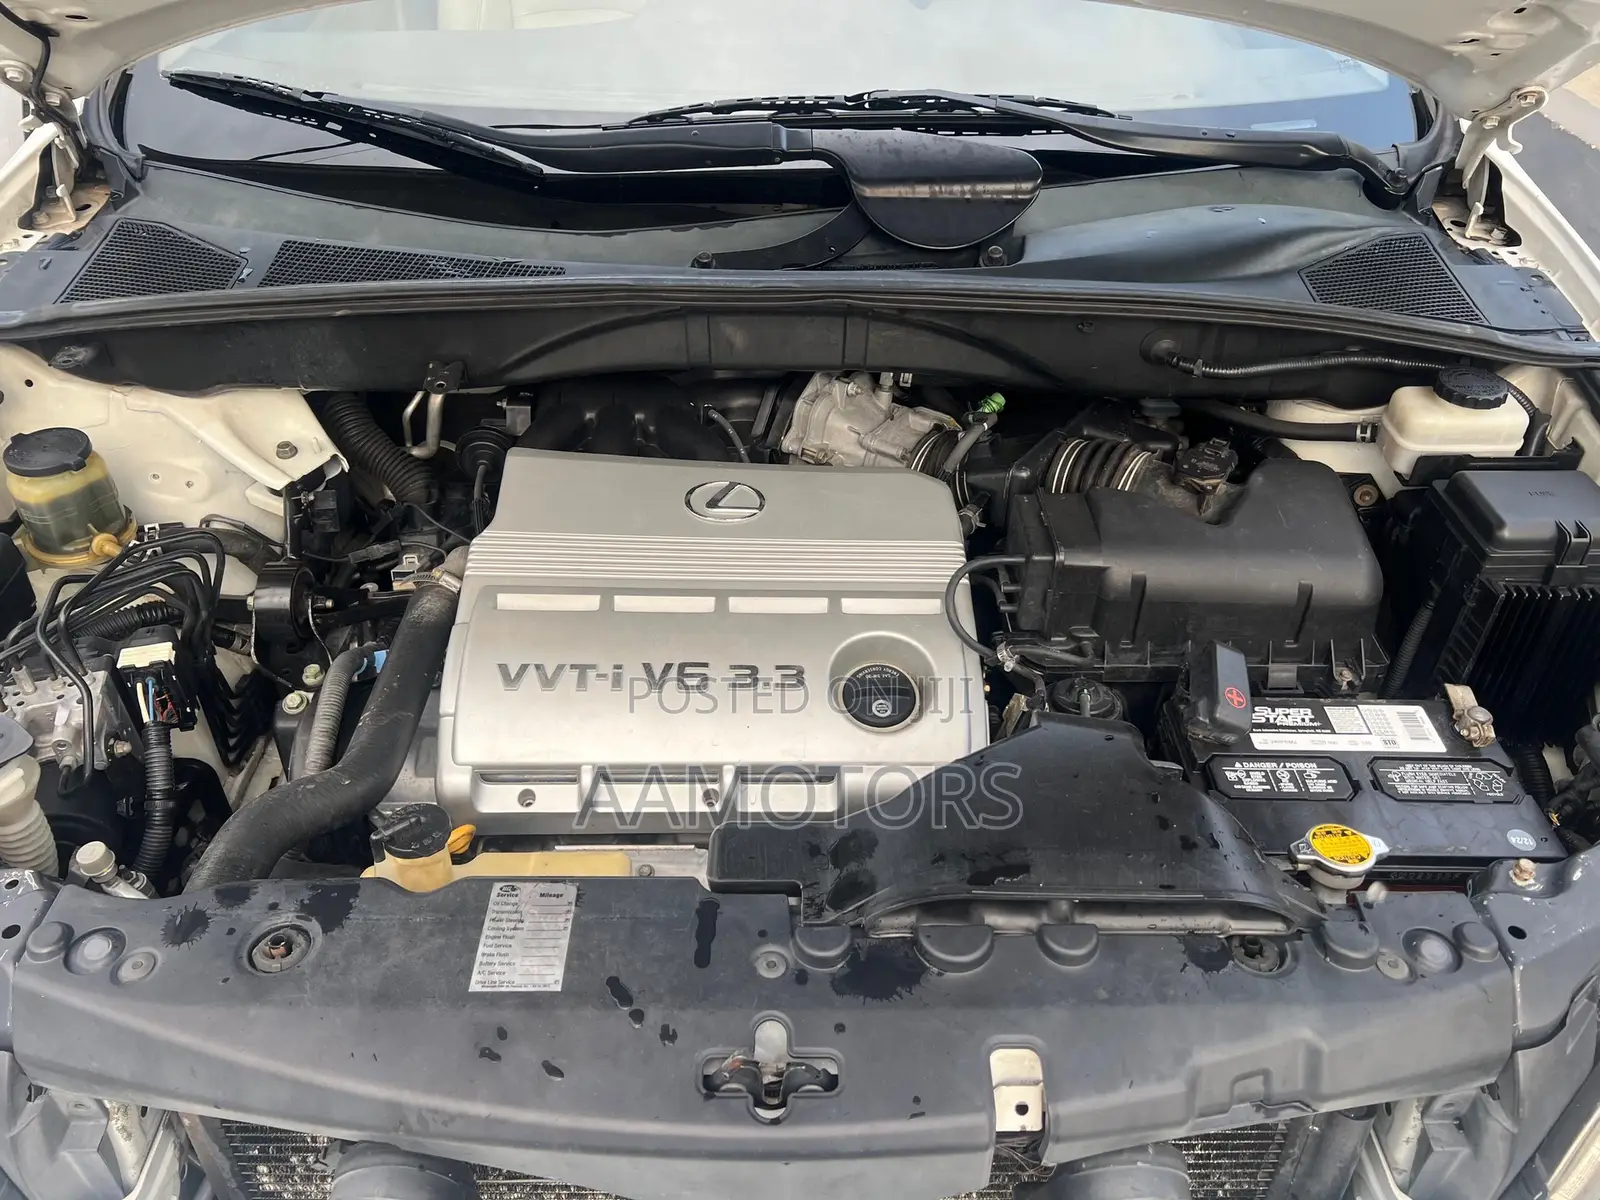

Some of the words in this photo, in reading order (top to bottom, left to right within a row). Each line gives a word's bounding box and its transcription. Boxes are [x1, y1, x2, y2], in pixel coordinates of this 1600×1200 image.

[497, 663, 624, 691] VVT-i
[641, 662, 710, 693] V6
[727, 664, 806, 691] 3.3
[1254, 706, 1312, 715] SUPER
[1252, 713, 1315, 723] START
